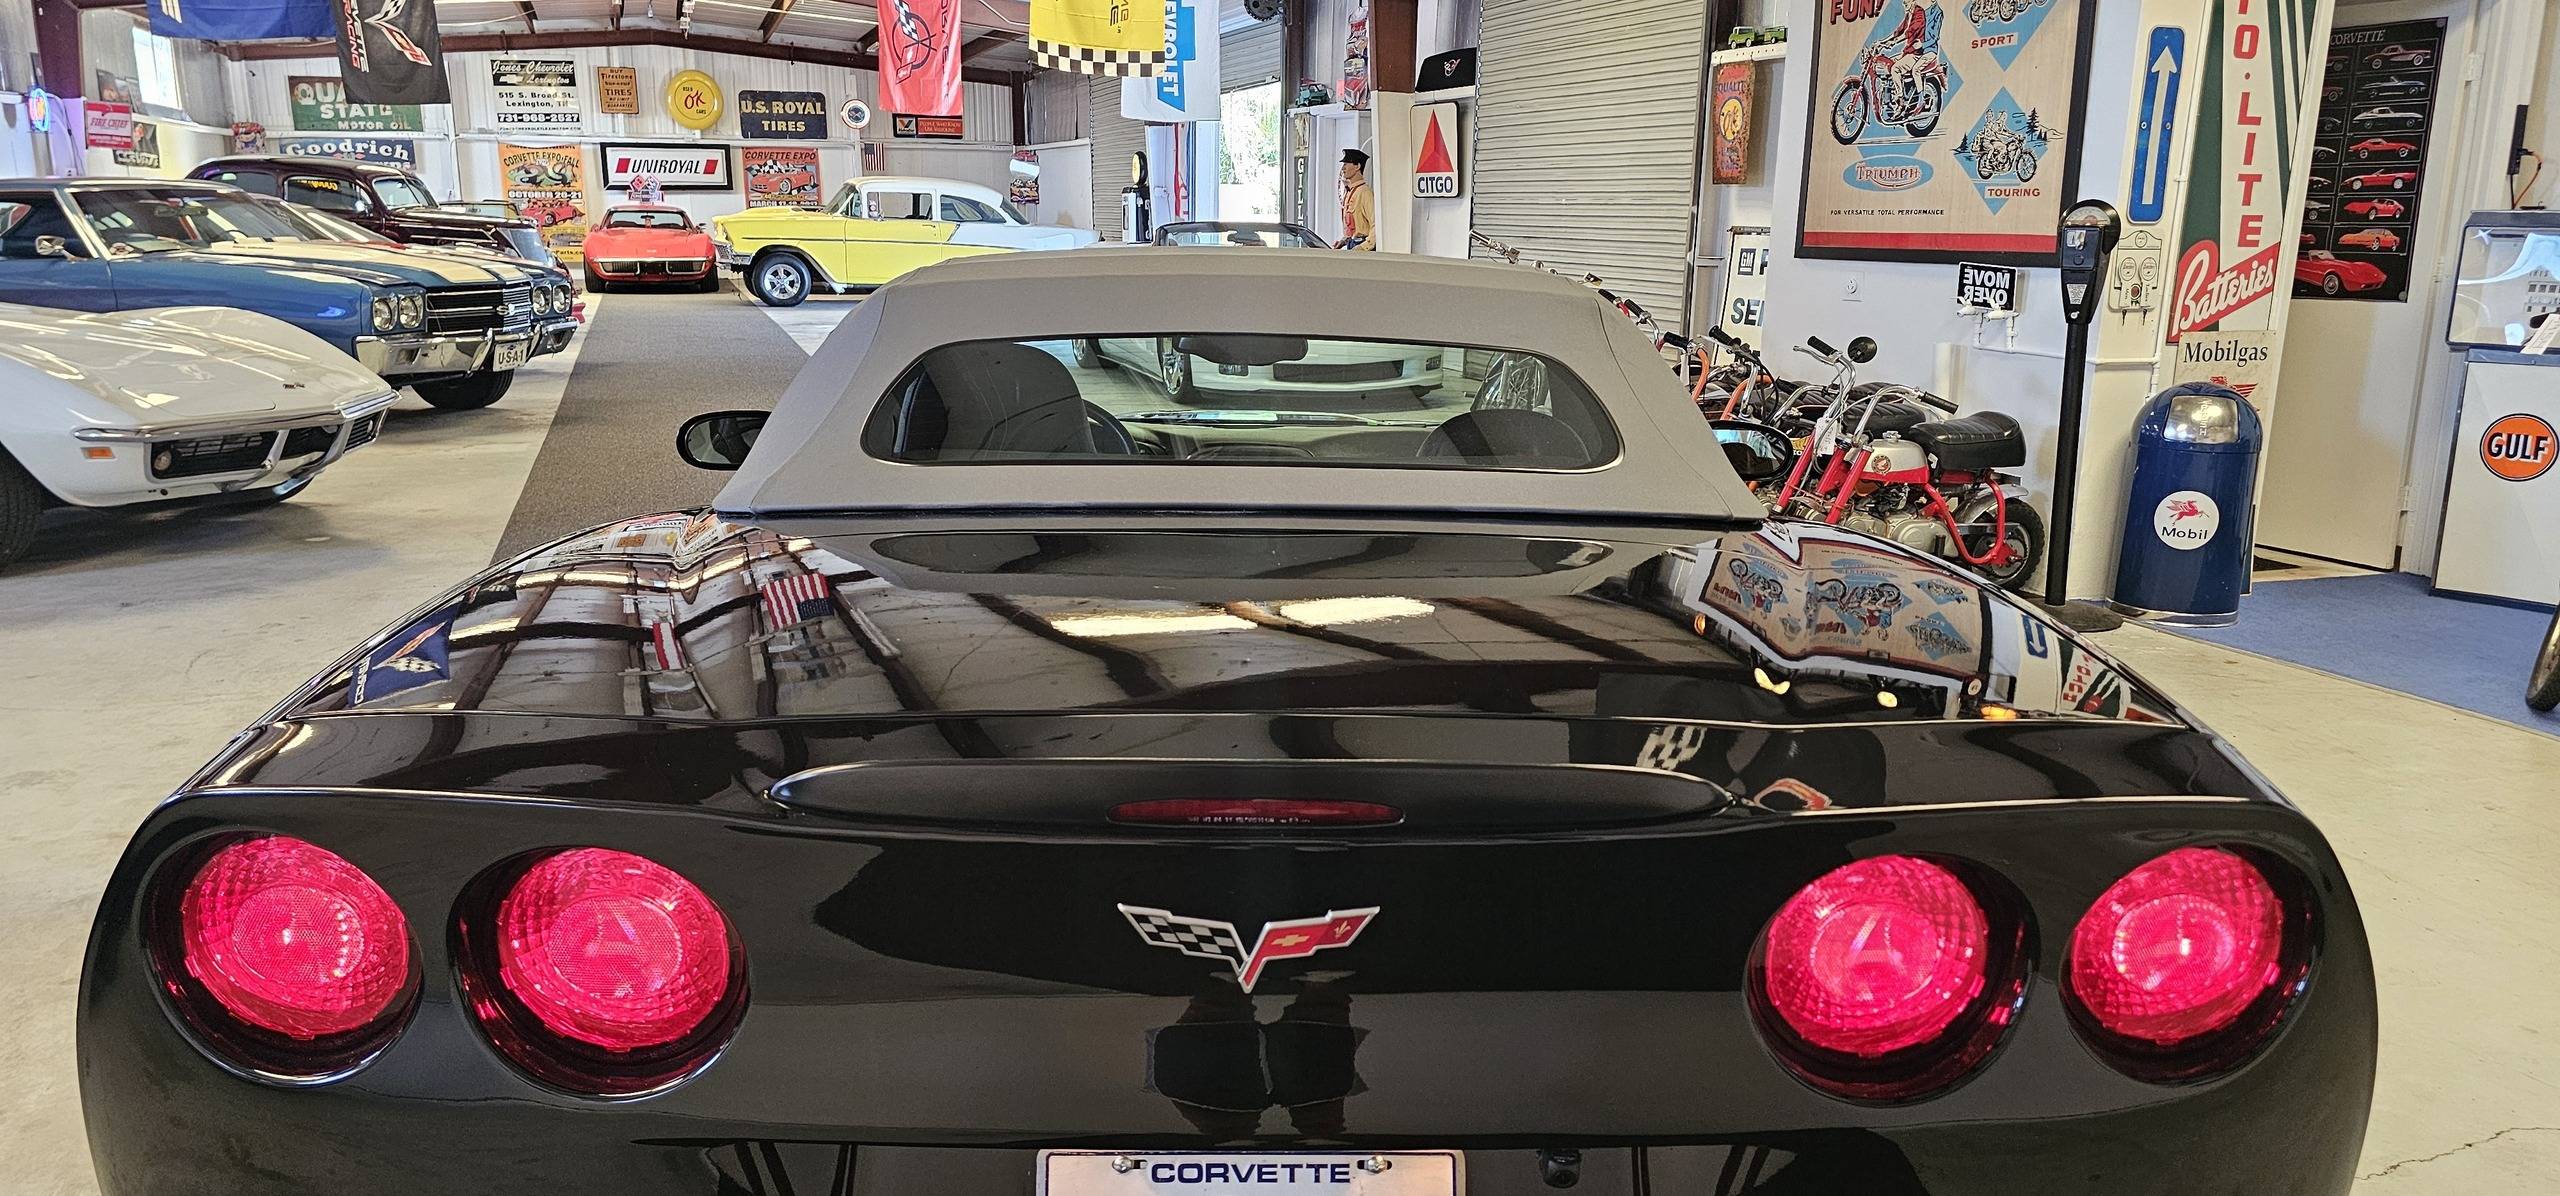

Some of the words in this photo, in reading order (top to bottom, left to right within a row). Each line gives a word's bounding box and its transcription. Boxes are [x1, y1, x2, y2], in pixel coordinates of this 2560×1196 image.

[1971, 34, 2014, 49] SPORT
[2329, 29, 2386, 46] CORVETTE
[492, 61, 521, 75] Jones
[526, 60, 574, 74] Chevrolet
[526, 74, 570, 84] Lexington
[684, 90, 706, 109] OK
[320, 104, 393, 119] STATE
[740, 101, 769, 114] U.S.
[772, 101, 825, 114] ROYAL
[498, 113, 579, 122] 731-968-2527
[337, 121, 384, 130] MOTOR
[389, 121, 412, 130] OIL
[762, 119, 806, 132] TIRES
[285, 139, 409, 161] Goodrich
[745, 151, 790, 160] CORVETTE
[793, 152, 816, 160] EXPO
[503, 151, 541, 167] CORVETTE
[631, 159, 701, 174] UNIROYAL
[1856, 163, 1921, 183] TRIUMPH
[1417, 176, 1453, 193] CITGO
[508, 190, 554, 199] OCTOBER
[555, 190, 582, 199] 20-21
[1987, 188, 2041, 198] TOURING
[1843, 208, 1875, 216] VERSATILE
[1740, 251, 1755, 268] GM
[2171, 249, 2275, 338] Batteries
[2183, 339, 2269, 368] Mobilgas
[2487, 432, 2548, 461] GULF
[2161, 526, 2208, 540] Mobil
[1150, 1162, 1351, 1184] CORVETTE
